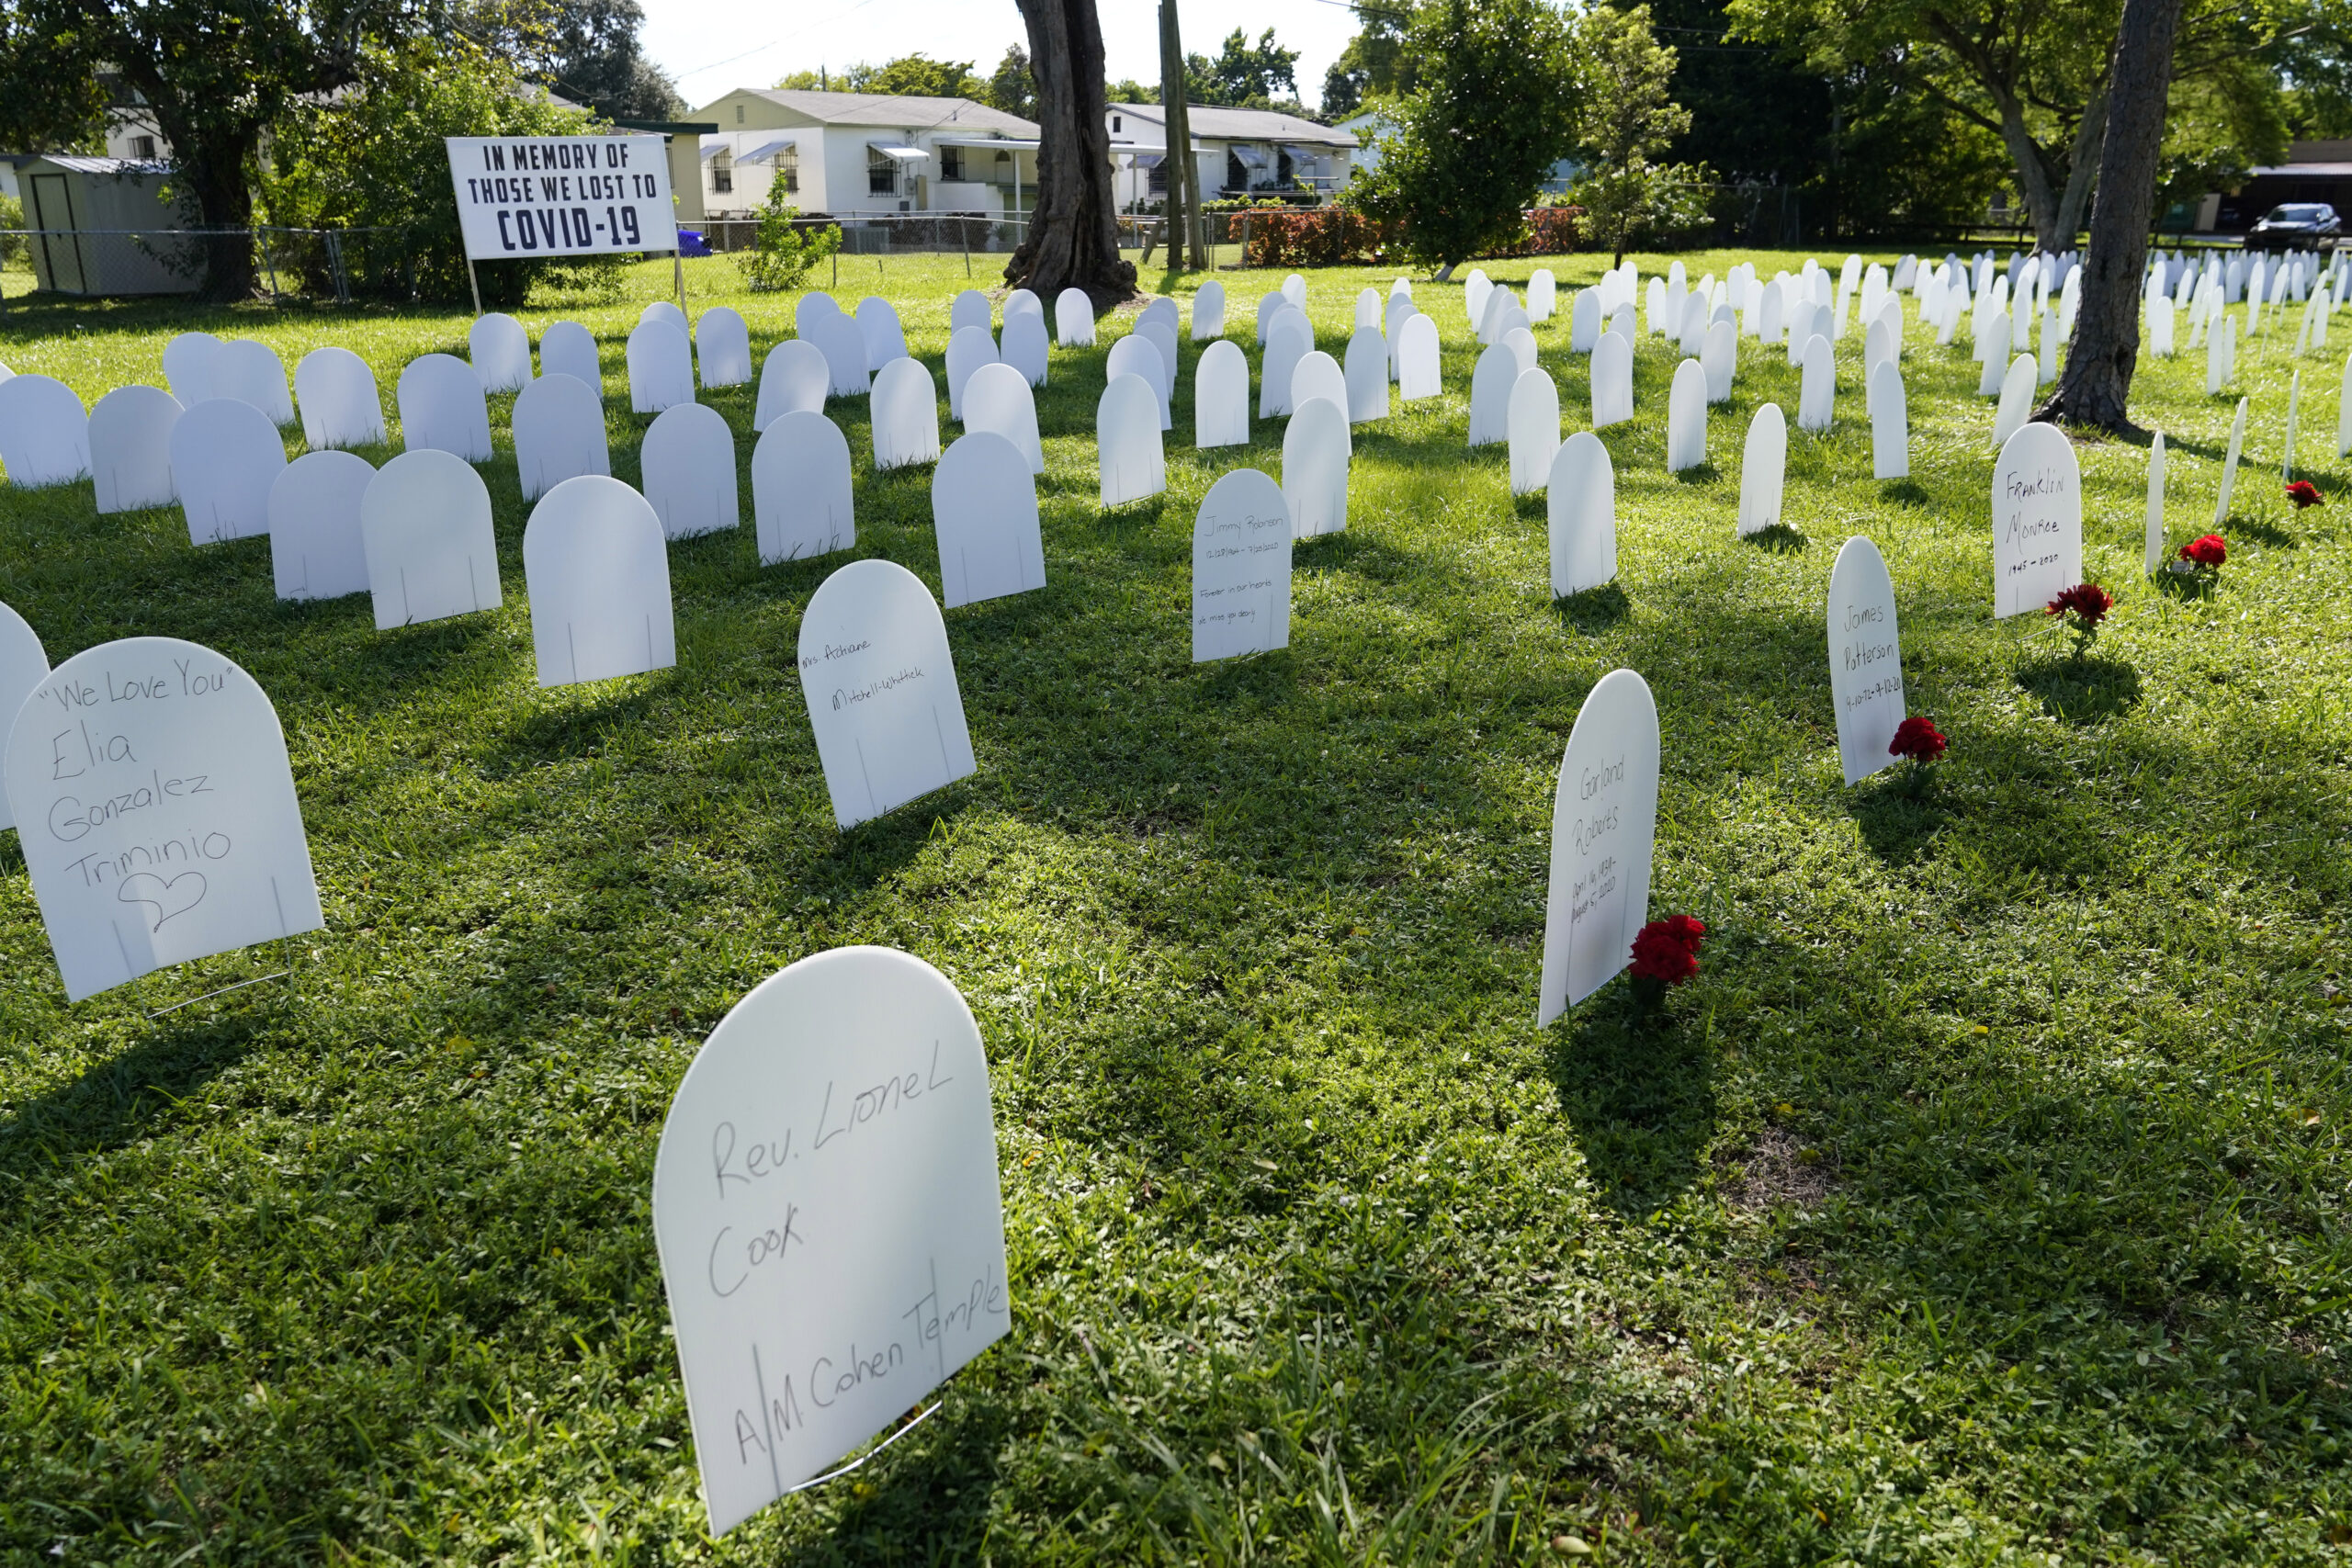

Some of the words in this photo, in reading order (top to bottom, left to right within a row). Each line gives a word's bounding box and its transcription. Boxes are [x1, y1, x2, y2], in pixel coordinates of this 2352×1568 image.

[482, 145, 505, 172] IN
[512, 143, 597, 171] MEMORY
[605, 142, 628, 168] OF
[468, 177, 534, 204] THOSE
[540, 176, 571, 202] WE
[578, 175, 625, 201] LOST
[632, 174, 657, 198] TO
[497, 205, 641, 251] COVID-19
[1204, 515, 1240, 539] Jimmy
[2008, 559, 2029, 577] 1945
[2039, 553, 2060, 566] 2020
[1227, 586, 1236, 594] in
[1249, 577, 1272, 589] hearts
[1209, 614, 1225, 623] miss
[1227, 610, 1237, 626] you
[1844, 605, 1883, 632] James
[1844, 642, 1894, 671] Patterson
[106, 671, 170, 704] Love
[52, 719, 138, 782] Elia
[1580, 754, 1624, 800] Garland
[48, 768, 215, 842] Gonzalez
[1572, 874, 1587, 902] April
[1599, 875, 1616, 900] 2020
[712, 1121, 800, 1201] Rev.
[707, 1201, 805, 1299] Cook
[809, 1343, 904, 1408] Cohen
[901, 1262, 1007, 1350] Temple
